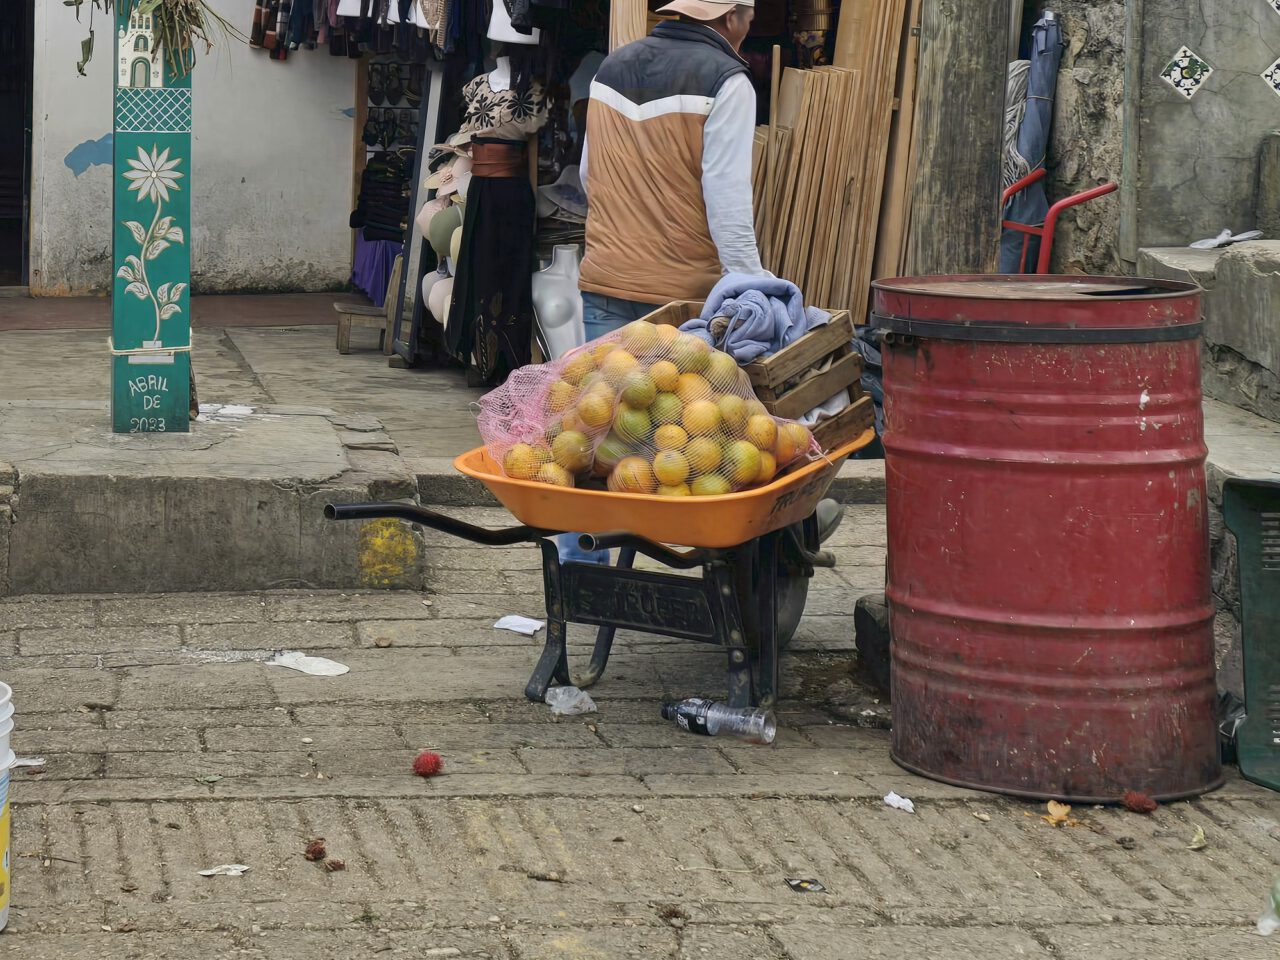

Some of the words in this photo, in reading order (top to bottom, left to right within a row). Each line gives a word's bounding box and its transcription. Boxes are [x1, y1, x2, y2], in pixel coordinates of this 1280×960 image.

[128, 374, 169, 397] ABRIL
[143, 394, 161, 410] DE
[129, 417, 166, 433] 2023
